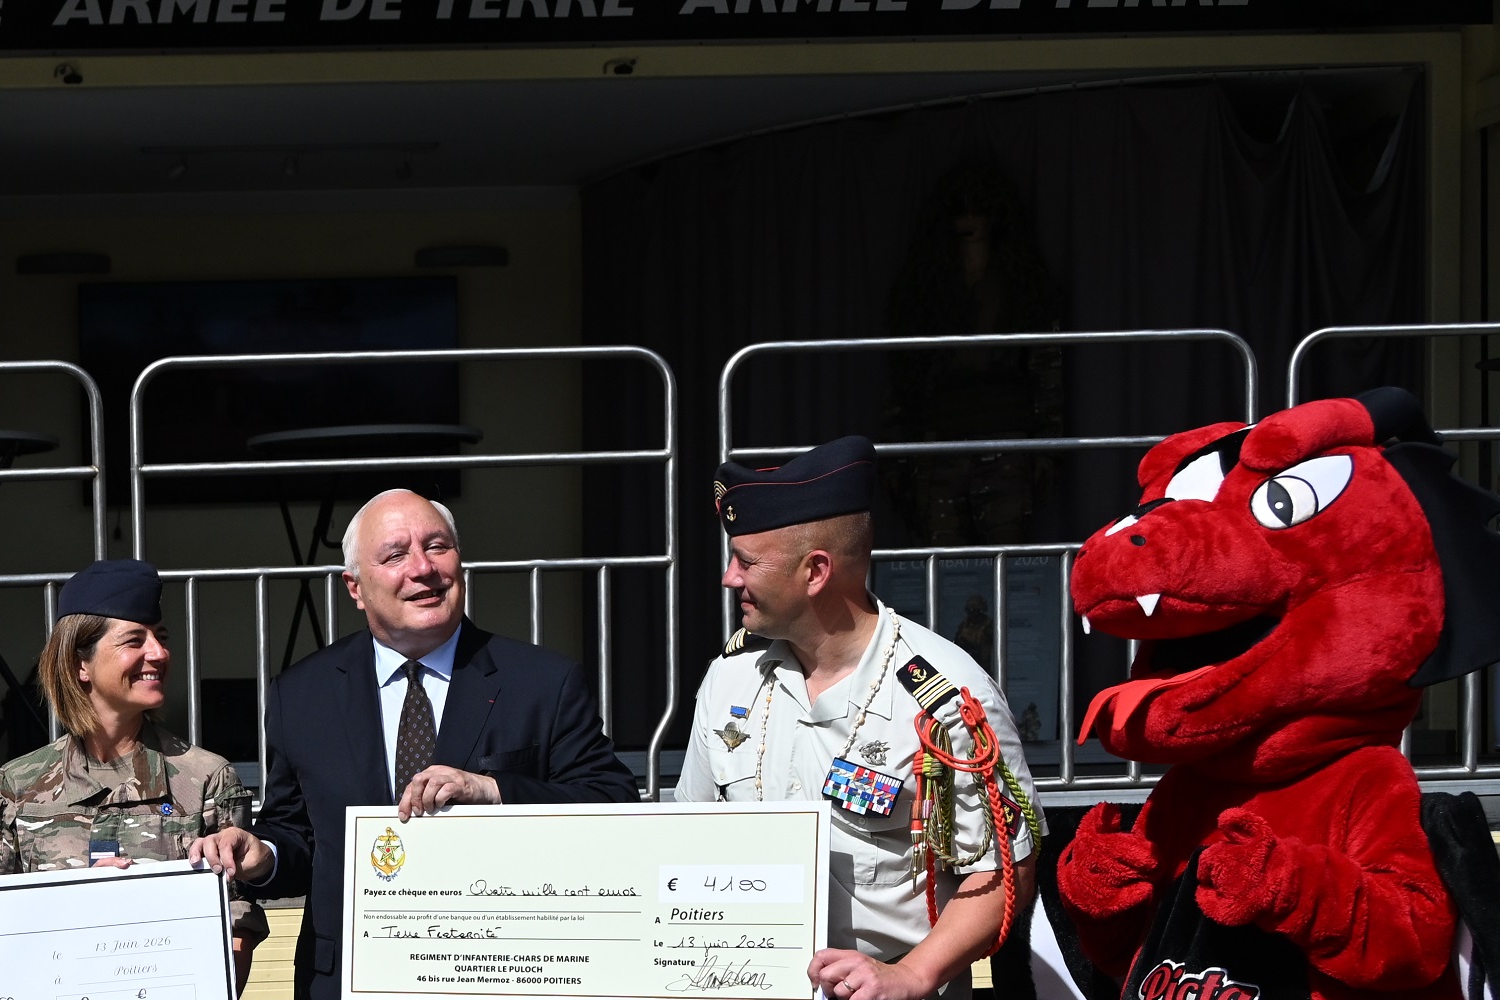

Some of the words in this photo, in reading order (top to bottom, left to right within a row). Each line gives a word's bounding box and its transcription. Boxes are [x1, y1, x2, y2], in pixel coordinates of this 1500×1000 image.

[667, 877, 679, 892] €
[363, 888, 387, 898] Payez
[398, 888, 427, 898] chèque
[439, 889, 463, 897] euros
[564, 885, 591, 897] cent
[670, 907, 725, 921] Poitiers
[654, 916, 661, 924] A
[363, 930, 369, 938] A
[143, 935, 172, 948] 2026
[653, 939, 664, 948] Le
[672, 936, 695, 949] 13
[701, 936, 729, 957] juin
[735, 934, 775, 949] 2026
[409, 953, 452, 961] REGIMENT
[453, 954, 542, 962] D'INFANTERIE-CHARS
[556, 955, 590, 963] MARINE
[653, 958, 696, 968] Signature
[113, 963, 159, 977] Poitiers
[454, 965, 496, 973] QUARTIER
[498, 965, 507, 973] LE
[416, 975, 427, 983] 46
[428, 975, 440, 983] bis
[477, 976, 510, 984] Mermoz
[543, 977, 582, 985] POITIERS
[135, 987, 147, 1000] €
